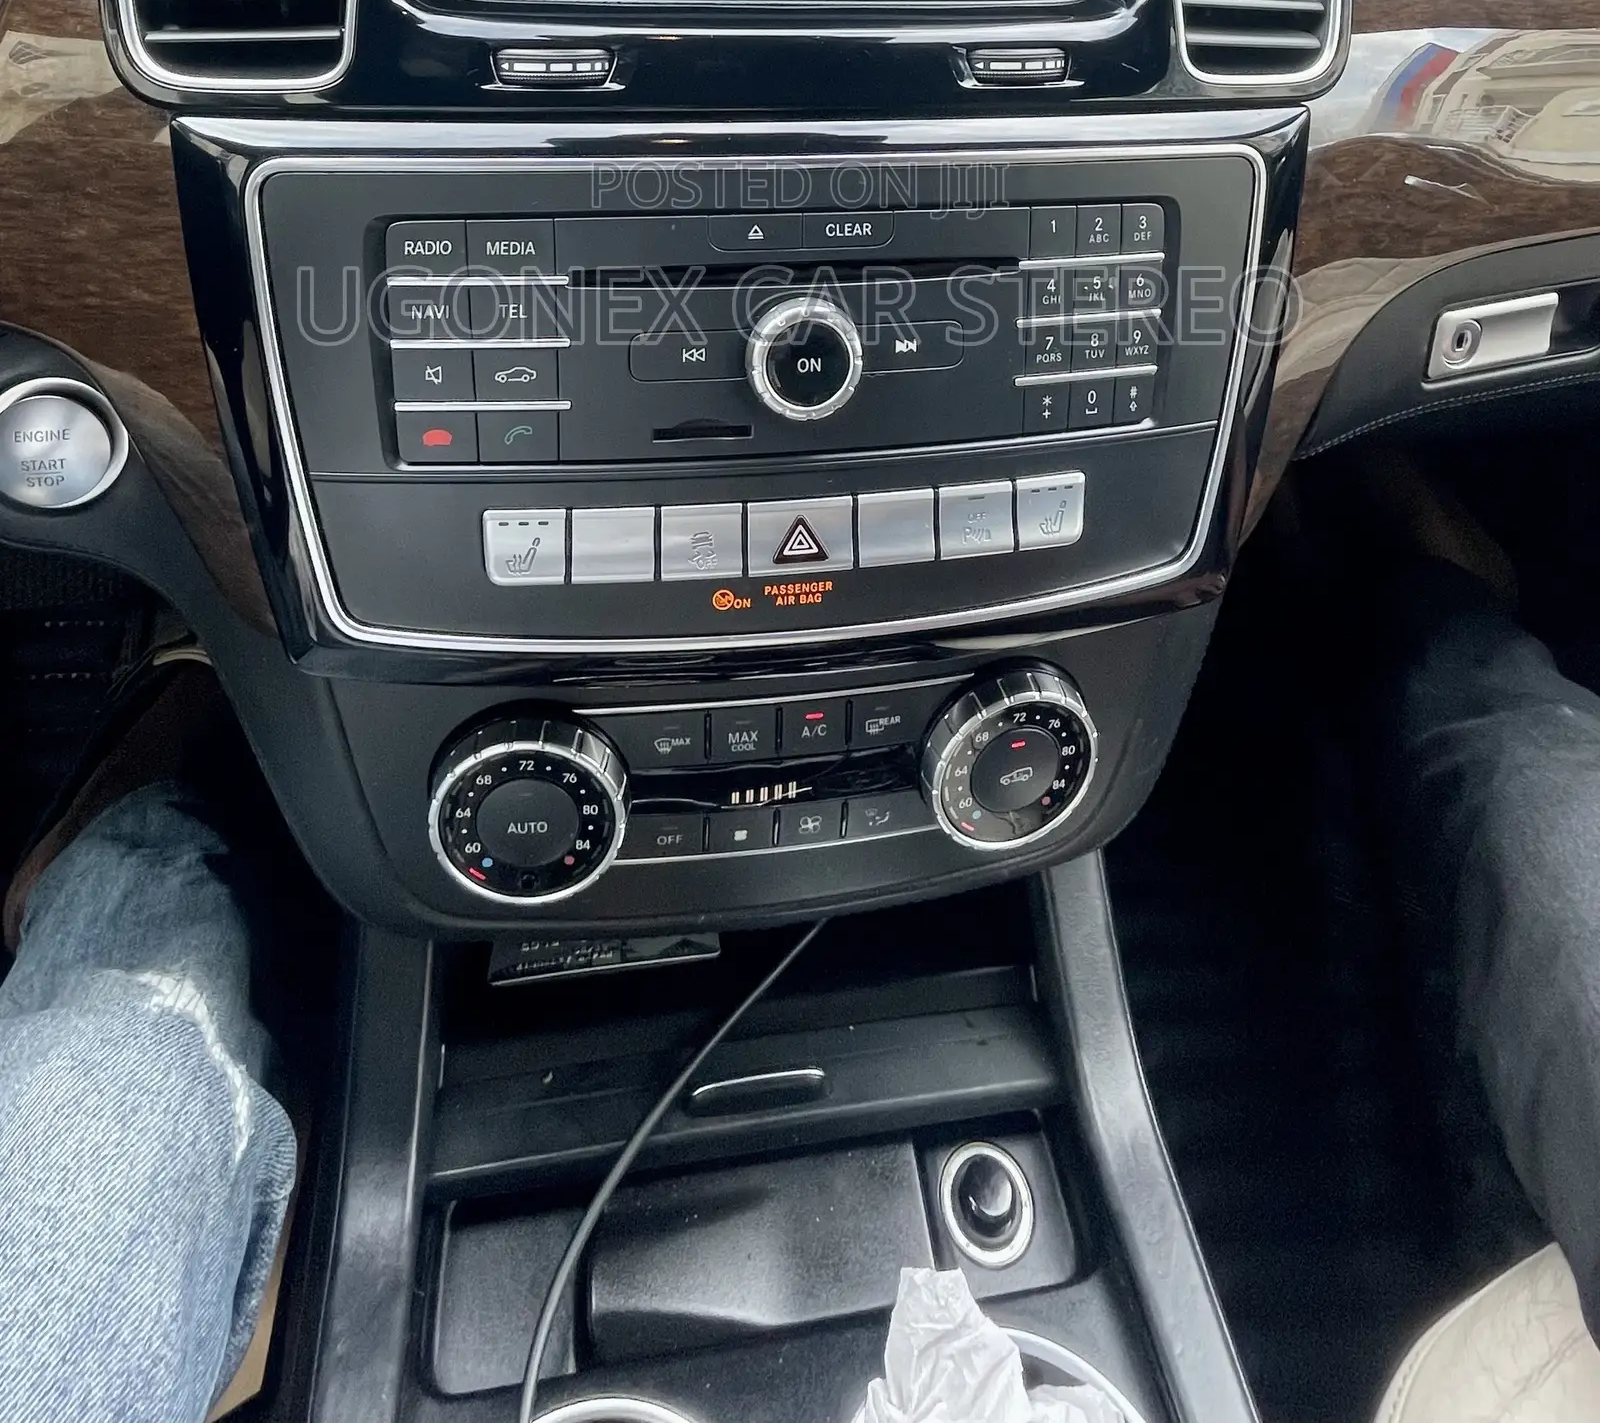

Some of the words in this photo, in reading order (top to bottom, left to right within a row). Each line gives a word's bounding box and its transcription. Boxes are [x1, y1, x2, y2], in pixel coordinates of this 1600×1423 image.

[1050, 219, 1057, 233] 1
[1094, 217, 1103, 231] 2
[1138, 215, 1147, 229] 3
[824, 222, 873, 238] CLEAR
[1133, 231, 1152, 241] DEF
[1088, 233, 1110, 243] ABC
[404, 239, 453, 257] RADIO
[486, 239, 536, 257] MEDIA
[1046, 278, 1056, 292] 4
[1093, 276, 1101, 289] 5
[1136, 274, 1145, 287] 6
[1088, 292, 1106, 302] JKL
[1128, 289, 1151, 299] MNO
[411, 304, 449, 320] NAVI
[499, 304, 528, 319] TEL
[1090, 333, 1099, 347] 8
[1133, 330, 1142, 344] 9
[1045, 336, 1054, 351] 7
[1085, 349, 1105, 359] TUV
[1125, 345, 1150, 356] WXYZ
[1036, 352, 1062, 364] PQRS
[797, 357, 822, 373] ON
[14, 428, 71, 443] ENGINE
[21, 458, 66, 472] START
[26, 474, 65, 488] STOP
[764, 581, 833, 596] PASSENGER
[733, 598, 751, 609] ON
[776, 594, 795, 605] AIR
[800, 592, 822, 604] BAG
[879, 715, 901, 726] REAR
[1013, 713, 1027, 723] 72
[801, 724, 827, 737] A/C
[1048, 719, 1060, 730] 76
[671, 737, 691, 747] MAX
[728, 731, 758, 744] MAX
[975, 732, 989, 743] 68
[731, 742, 756, 752] COOL
[1062, 745, 1075, 756] 80
[519, 760, 534, 771] 72
[954, 765, 967, 776] 64
[476, 775, 492, 785] 68
[562, 772, 577, 784] 76
[1052, 779, 1065, 790] 84
[958, 797, 972, 809] 60
[455, 808, 471, 818] 64
[582, 804, 598, 815] 80
[507, 821, 548, 834] AUTO
[575, 839, 590, 851] 84
[656, 834, 683, 845] OFF
[464, 842, 481, 853] 60
